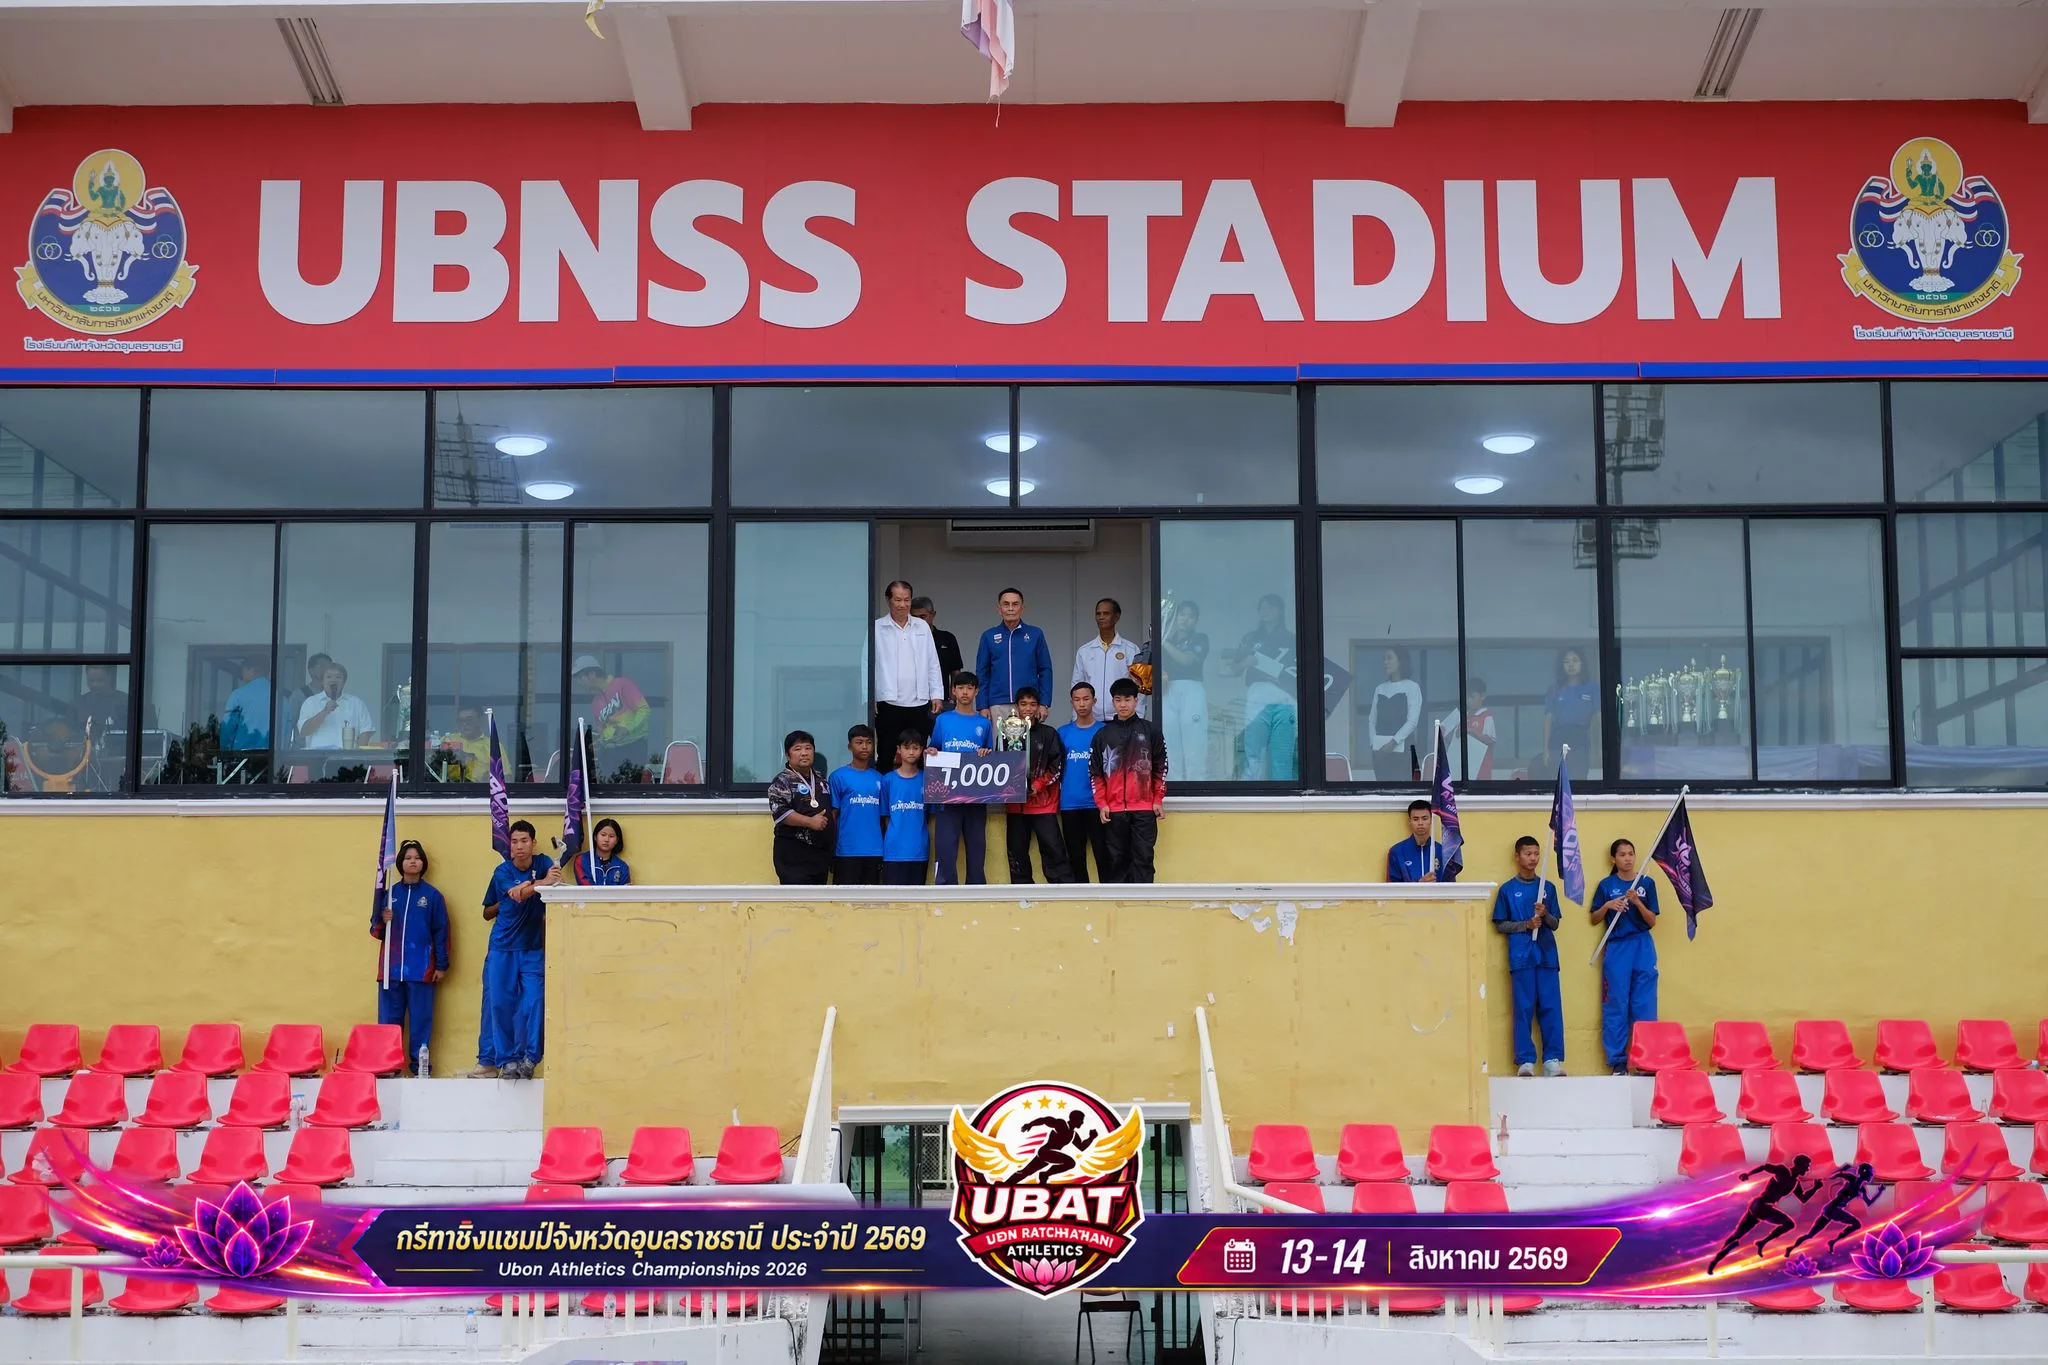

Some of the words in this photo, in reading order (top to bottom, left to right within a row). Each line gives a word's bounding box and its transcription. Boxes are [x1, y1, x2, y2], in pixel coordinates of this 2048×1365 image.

[258, 179, 862, 329] UBNSS
[965, 176, 1782, 325] STADIUM
[37, 290, 175, 328] มหาวิทยาลัยการกีฬาแห่งชาติ
[1863, 279, 2001, 317] มหาวิทยาลัยการกีฬาแห่งชาติ
